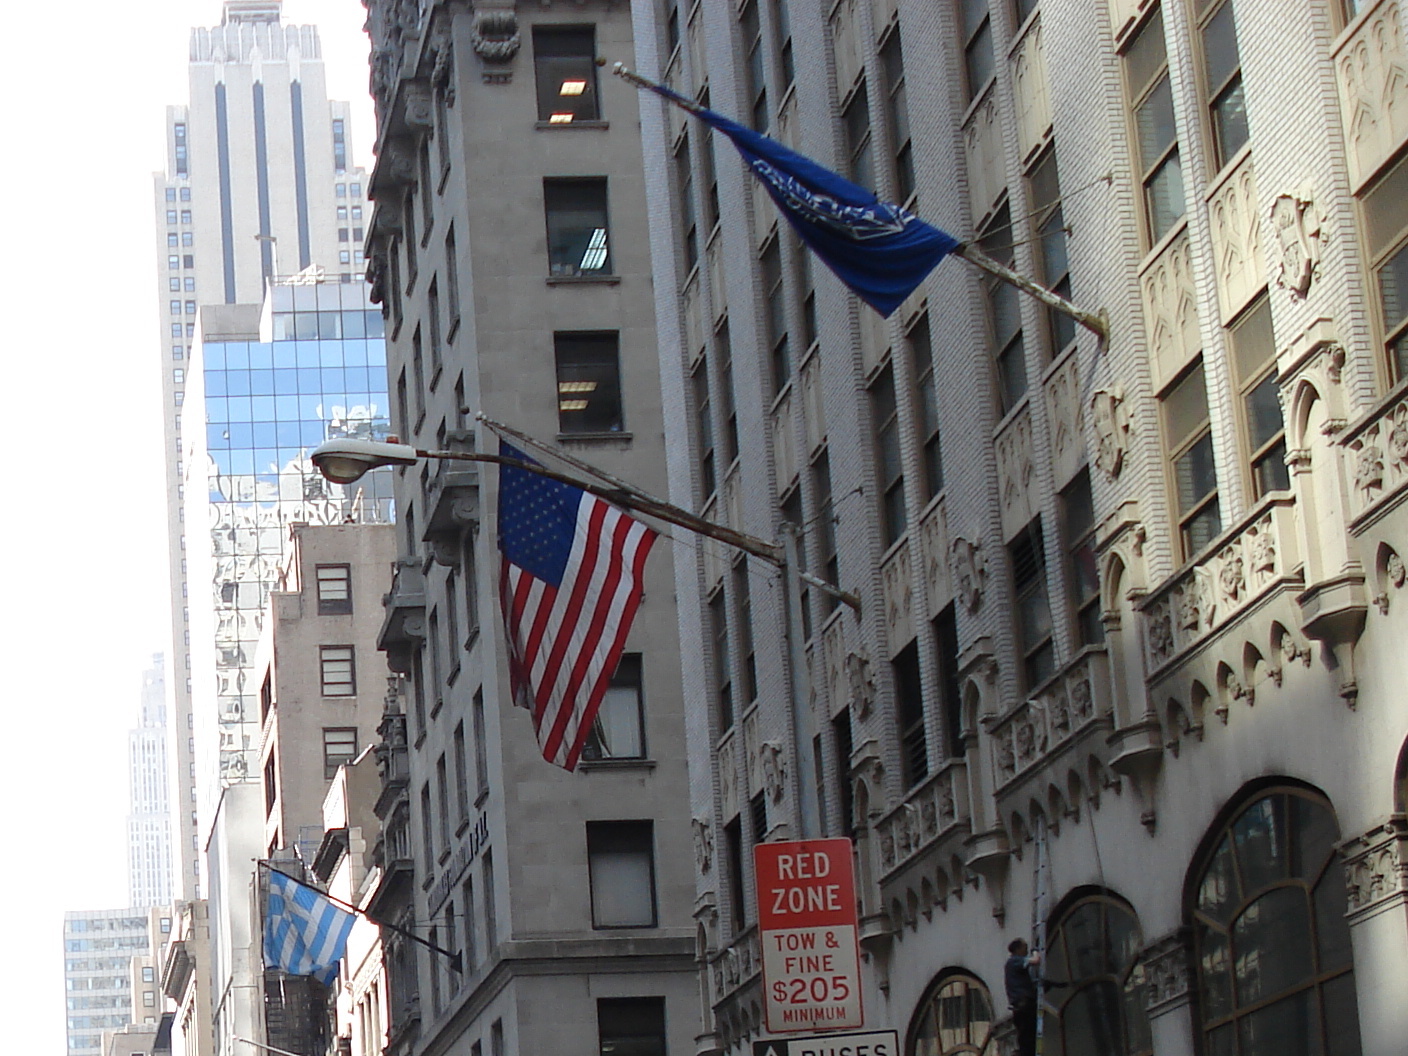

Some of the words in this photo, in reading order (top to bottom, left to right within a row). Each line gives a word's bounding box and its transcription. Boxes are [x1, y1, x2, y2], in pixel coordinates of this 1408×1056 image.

[777, 852, 830, 881] RED
[771, 884, 842, 915] ZONE
[774, 932, 816, 951] TOW
[825, 931, 840, 949] &
[785, 955, 835, 974] FINE
[773, 976, 849, 1005] $205
[783, 1007, 846, 1023] MINIMUM
